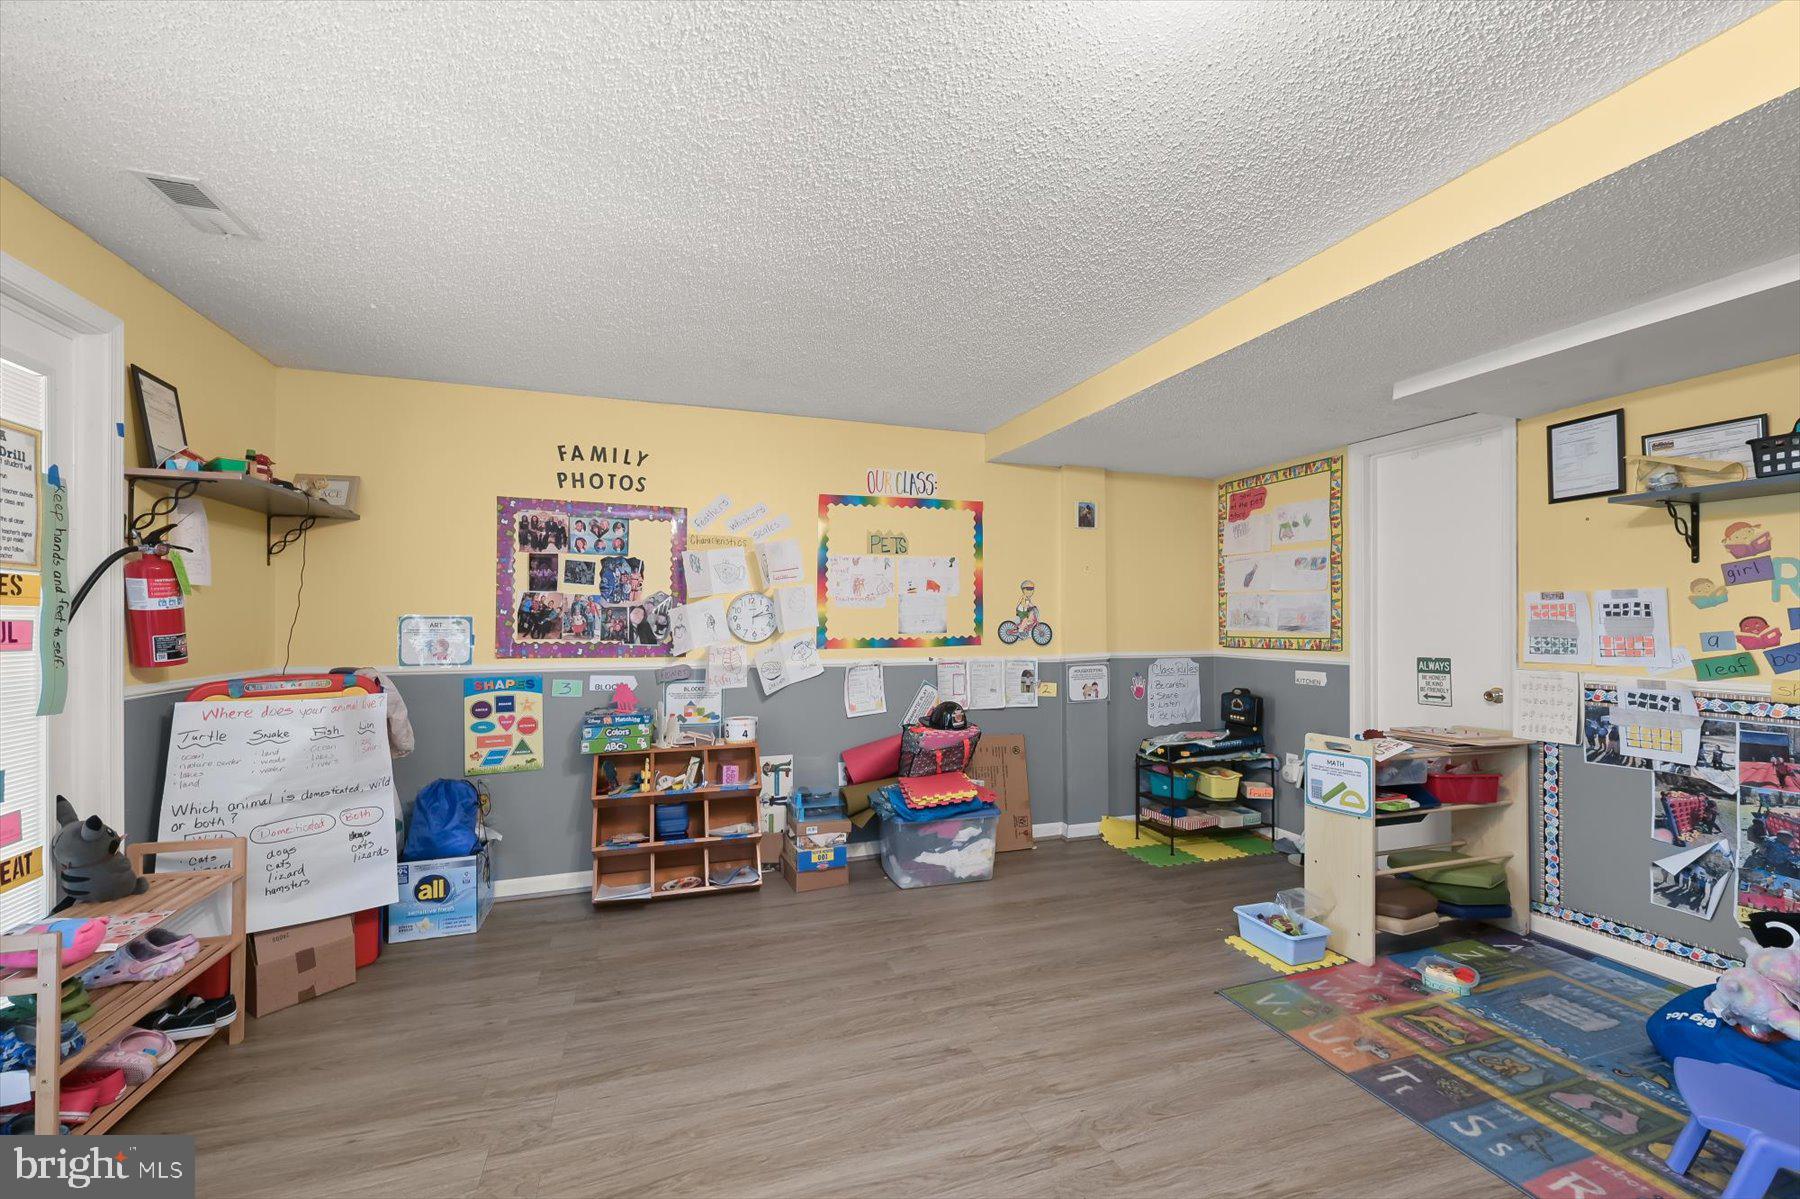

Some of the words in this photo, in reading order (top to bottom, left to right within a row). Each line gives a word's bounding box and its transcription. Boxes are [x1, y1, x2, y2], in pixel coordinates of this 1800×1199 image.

[557, 444, 649, 467] FAMILY
[557, 472, 647, 492] PHOTOS
[867, 470, 892, 494] OUR
[896, 471, 938, 495] CLASS:
[52, 528, 66, 567] hands
[870, 535, 907, 554] PETS
[1727, 562, 1760, 584] girl
[53, 571, 66, 594] and
[55, 599, 69, 622] feet
[54, 628, 64, 637] to
[1708, 635, 1719, 648] a
[1419, 661, 1450, 671] ALWAYS
[1705, 656, 1750, 678] leaf
[1773, 653, 1800, 667] bo
[474, 679, 536, 691] SHAPES
[558, 682, 572, 695] 3
[202, 705, 253, 721] Where
[261, 705, 294, 718] does
[300, 704, 327, 719] your
[178, 728, 228, 743] Turtle
[253, 729, 291, 740] Snake
[313, 726, 341, 737] Fish
[605, 728, 630, 736] Colors
[742, 730, 748, 738] 4
[1327, 760, 1345, 768] MATH
[180, 779, 201, 789] land
[171, 801, 219, 817] Which
[228, 793, 273, 812] animal
[281, 789, 296, 803] is
[367, 776, 391, 791] wild
[171, 821, 185, 832] or
[194, 815, 226, 830] both
[266, 846, 298, 861] dogs
[0, 852, 33, 886] EAT
[265, 860, 292, 873] cats
[268, 864, 306, 884] lizard
[264, 878, 311, 896] hamsters
[418, 879, 446, 900] all
[1308, 1024, 1350, 1044] U
[1377, 1065, 1423, 1083] T
[1451, 1114, 1499, 1137] S
[1488, 1142, 1514, 1157] s
[1592, 1159, 1650, 1193] robot
